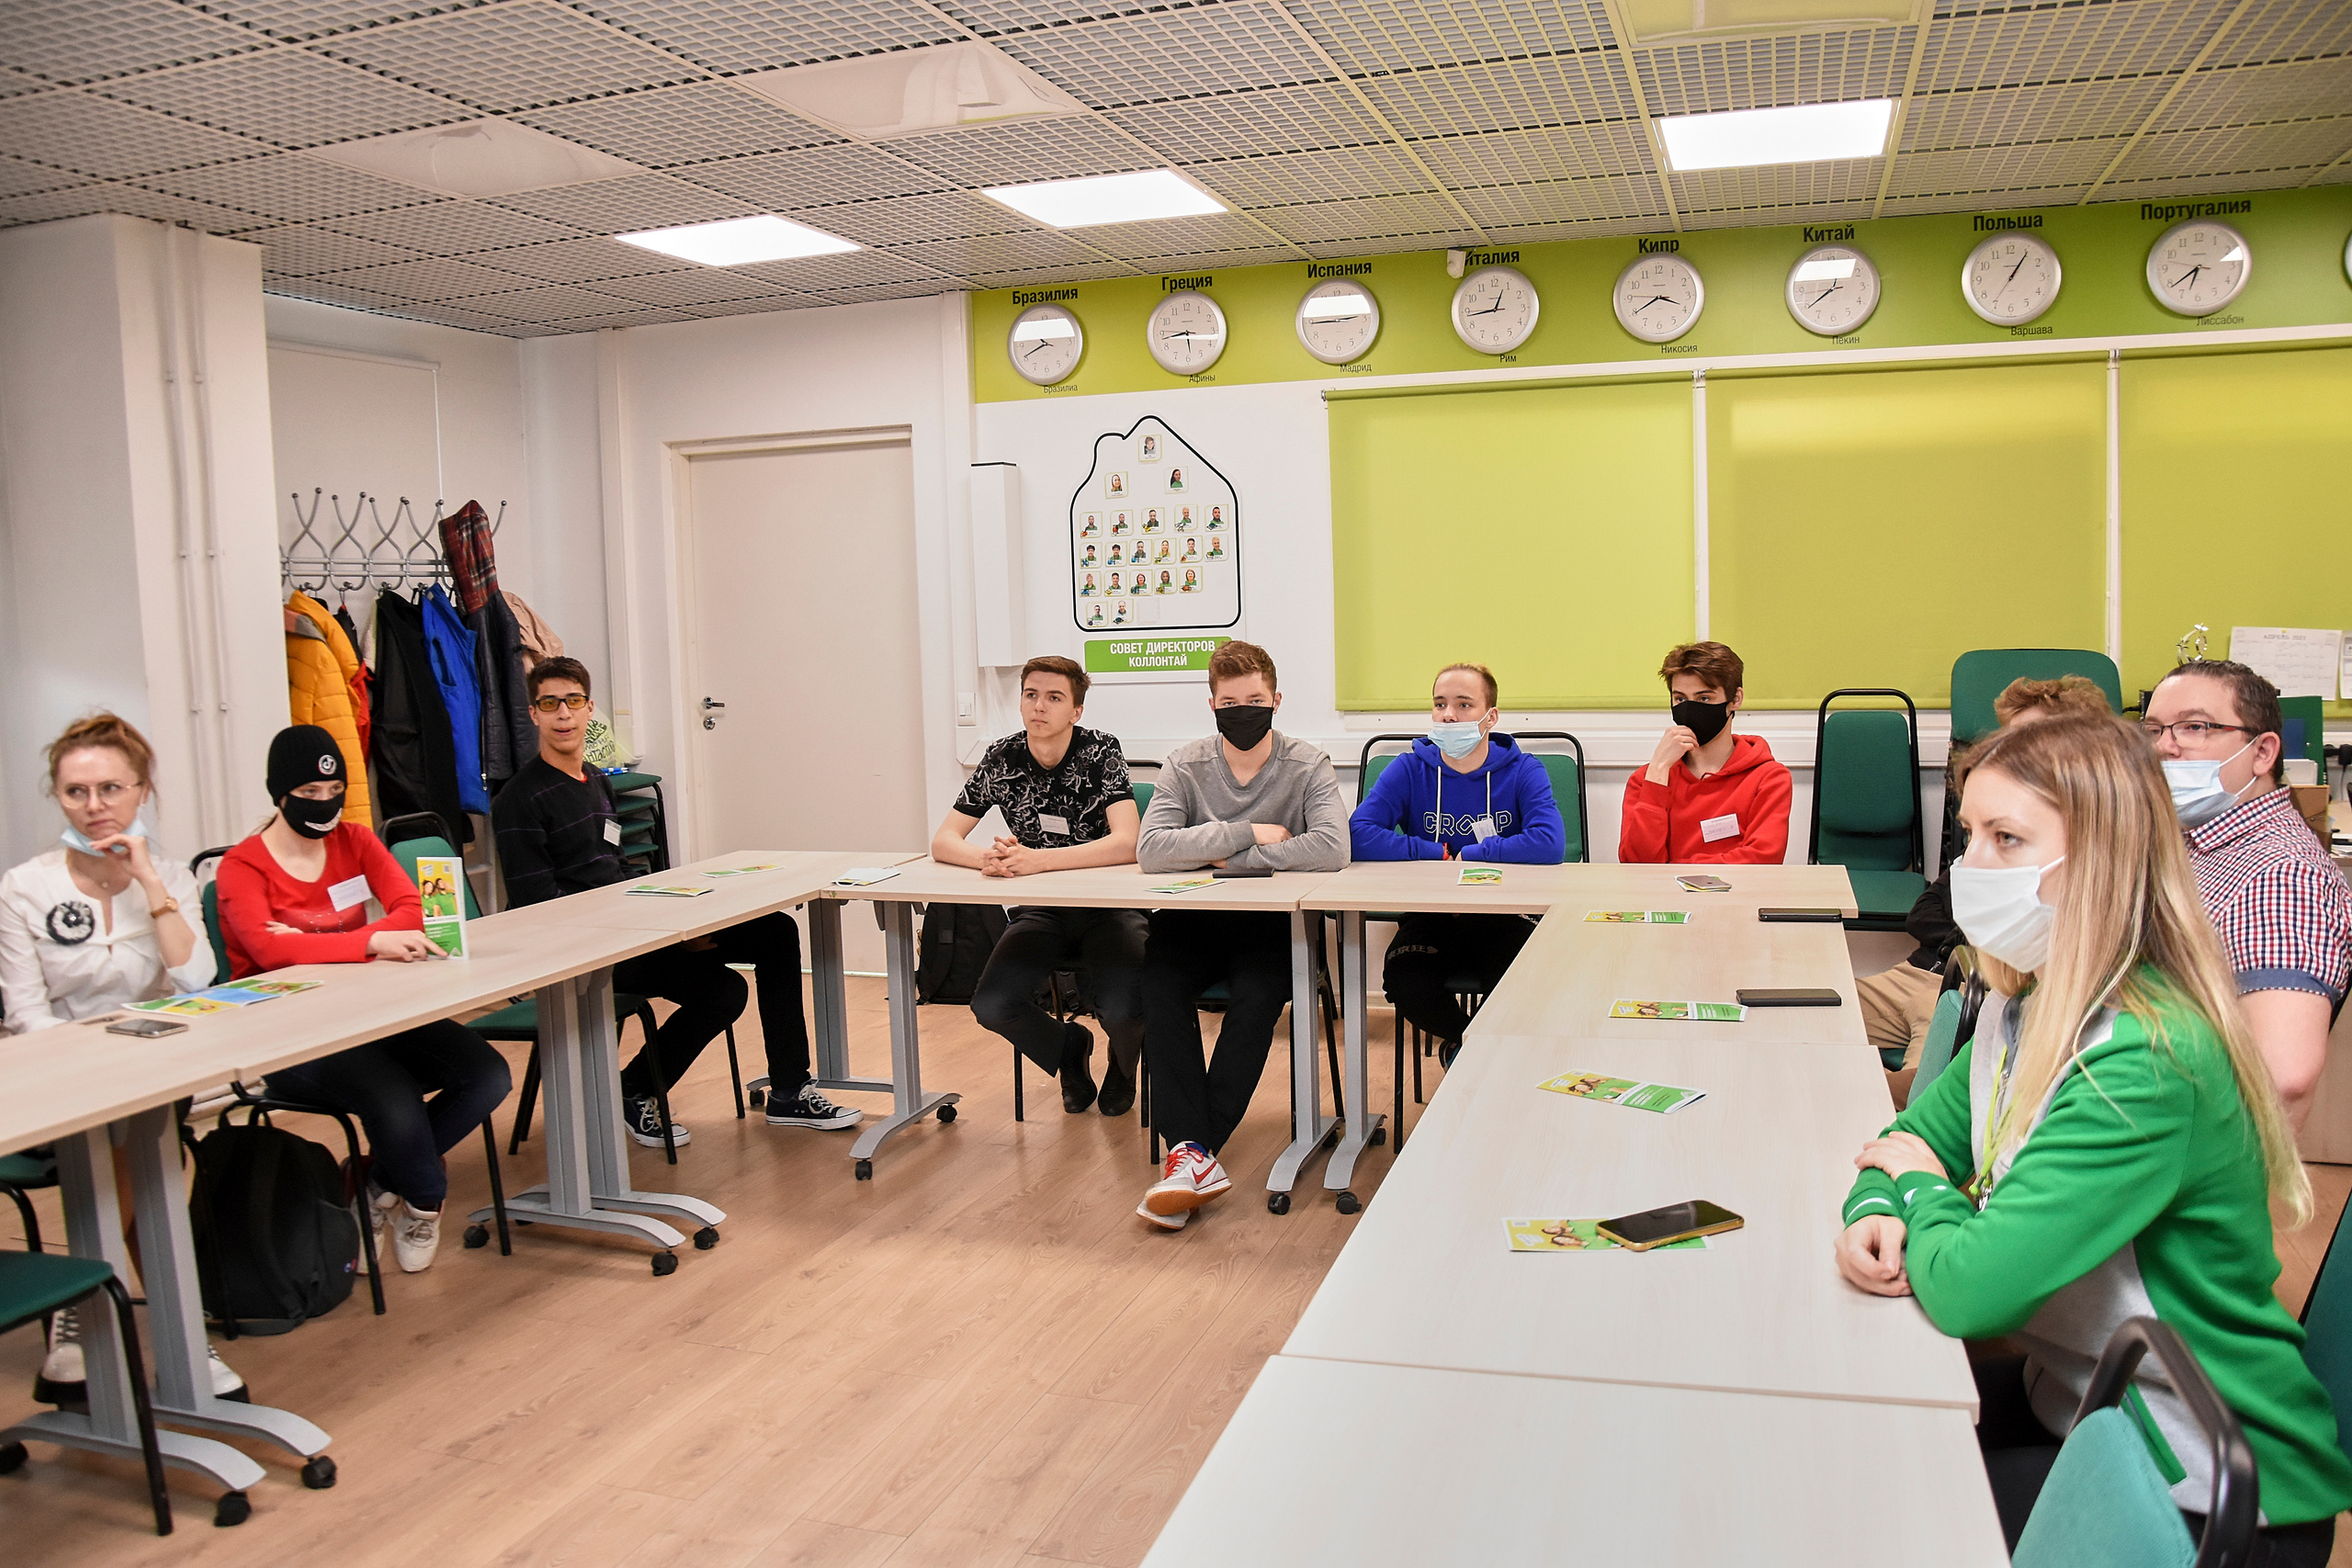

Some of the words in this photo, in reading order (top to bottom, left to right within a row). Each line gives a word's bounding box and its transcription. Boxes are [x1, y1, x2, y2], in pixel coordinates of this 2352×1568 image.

[2142, 200, 2251, 221] Португалия
[1973, 215, 2042, 231] Польша
[1804, 224, 1854, 242] Китай
[1639, 239, 1679, 254] Кипр
[1307, 263, 1372, 277] Испания
[1162, 276, 1213, 293] Греция
[1012, 288, 1078, 306] Бразилия
[2197, 315, 2244, 326] Лиссабон
[2011, 326, 2052, 336] Варшава
[1832, 336, 1860, 344] Пекин
[1661, 345, 1698, 354] Никосия
[1340, 364, 1372, 373] Мадрид
[1189, 374, 1216, 384] Афины
[1110, 642, 1143, 654] СОВЕТ
[1146, 641, 1216, 655] ДИРЕКТОРОВ
[1129, 653, 1187, 667] КОЛЛОНТАЙ
[1423, 810, 1512, 836] CROP
